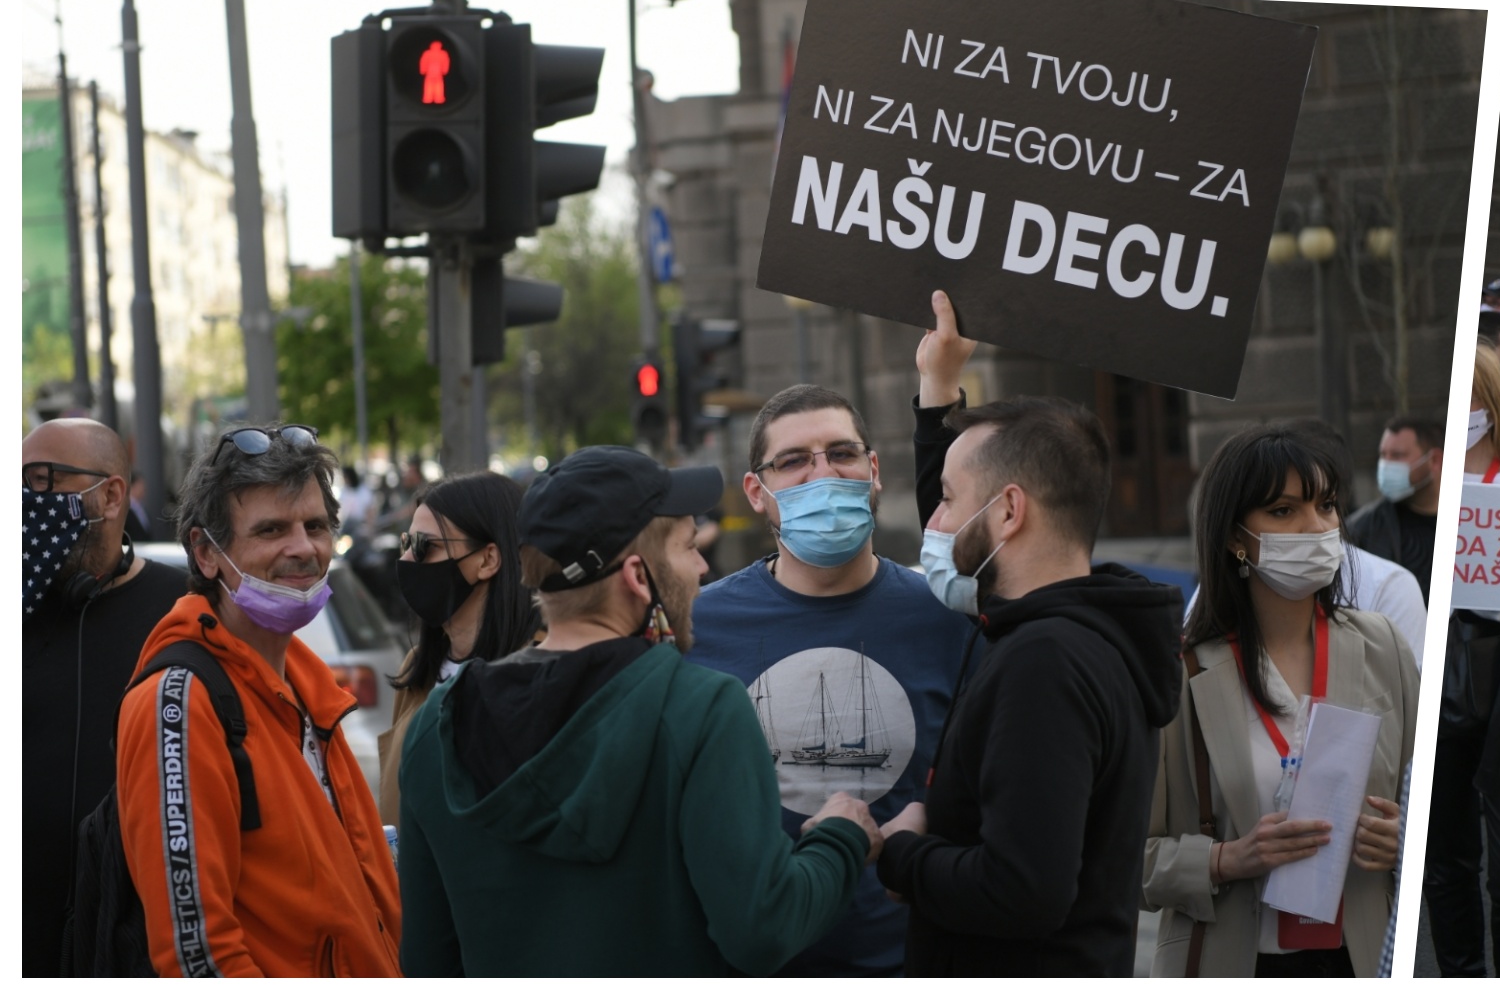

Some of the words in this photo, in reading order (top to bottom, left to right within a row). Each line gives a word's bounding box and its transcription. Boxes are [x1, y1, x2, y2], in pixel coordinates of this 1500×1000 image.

[901, 28, 945, 71] NI
[954, 39, 1011, 84] ZA
[1026, 51, 1180, 122] TVOJU,
[813, 85, 855, 126] NI
[864, 94, 918, 140] ZA
[932, 108, 1144, 184] NJEGOVU
[1190, 160, 1251, 207] ZA
[790, 154, 986, 261] NAŠU
[1001, 200, 1229, 318] DECU.
[163, 727, 189, 852] SUPERDRY
